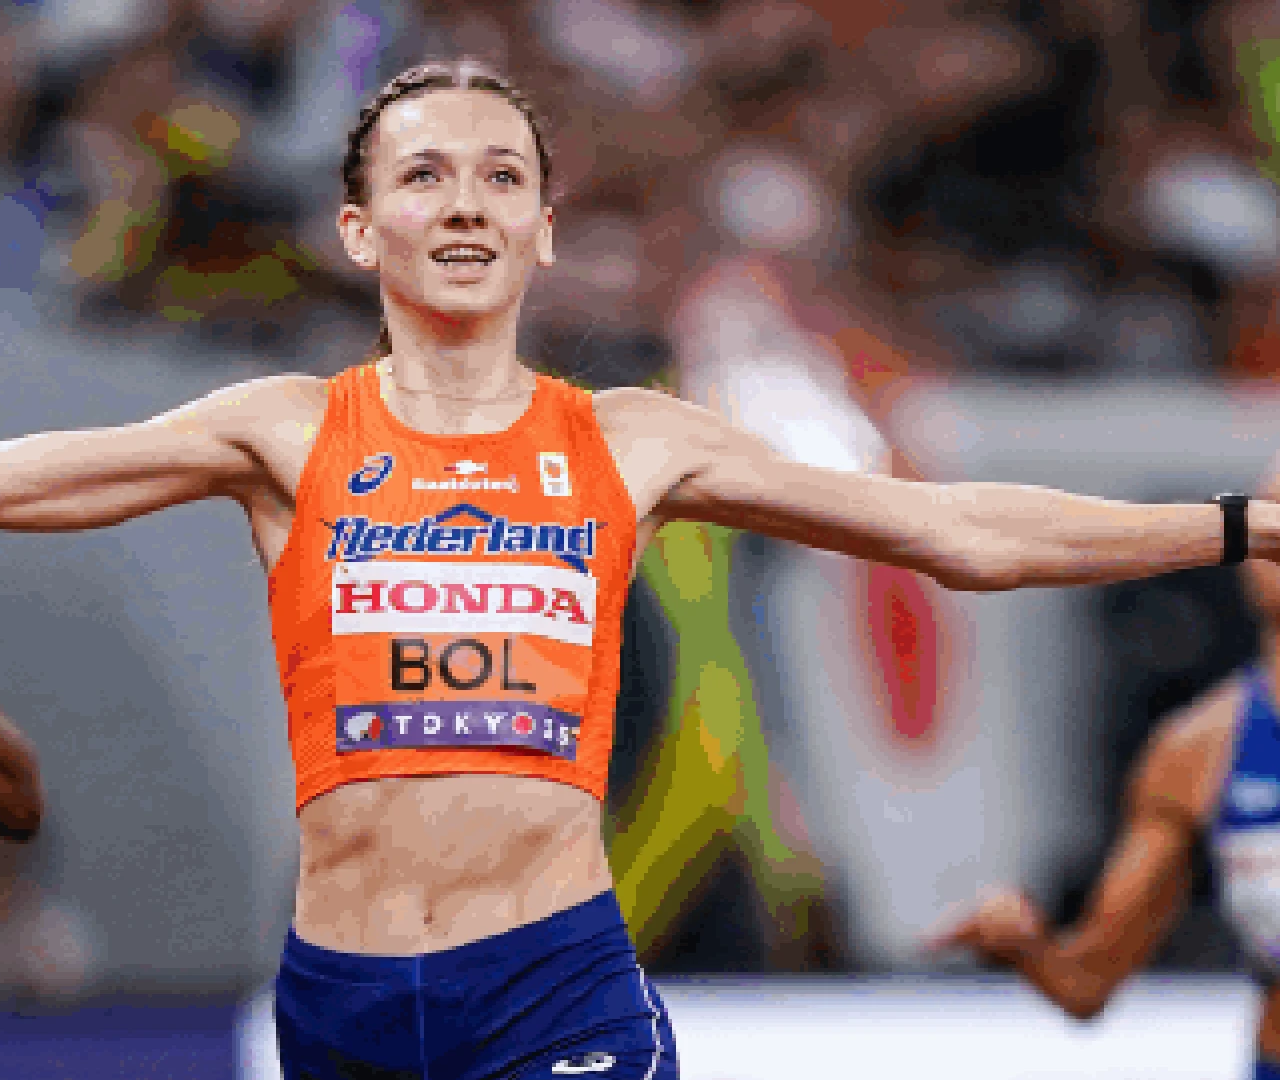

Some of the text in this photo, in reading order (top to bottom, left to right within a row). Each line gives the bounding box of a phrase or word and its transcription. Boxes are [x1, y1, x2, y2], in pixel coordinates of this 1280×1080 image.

[324, 516, 597, 563] Nederland
[335, 580, 589, 624] HONDA
[391, 638, 536, 691] BOL
